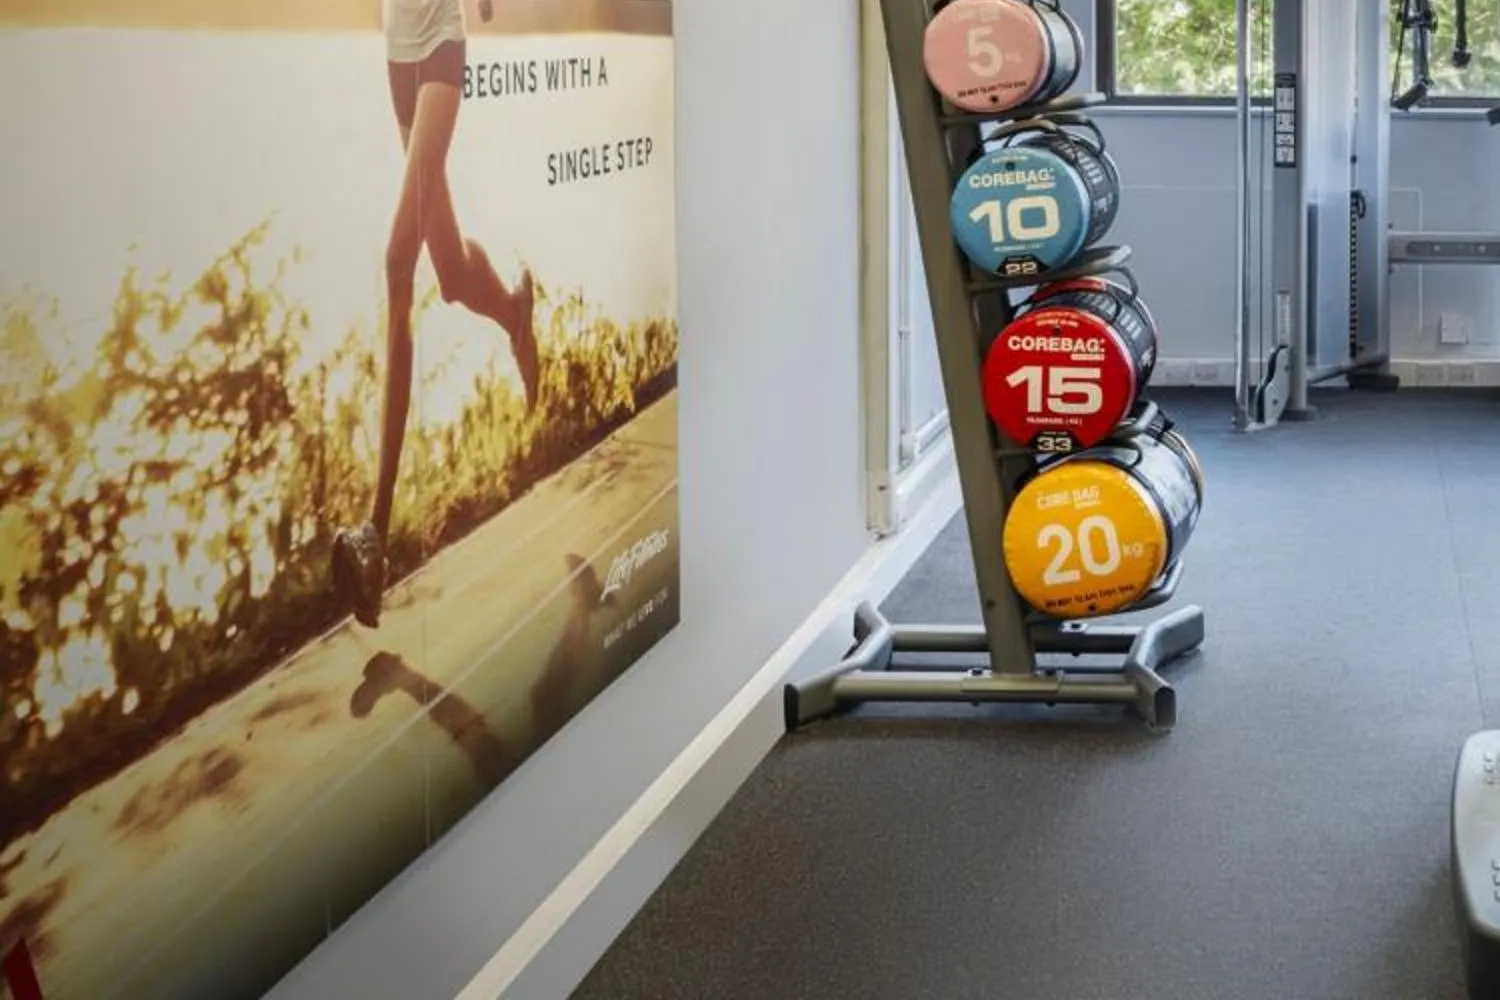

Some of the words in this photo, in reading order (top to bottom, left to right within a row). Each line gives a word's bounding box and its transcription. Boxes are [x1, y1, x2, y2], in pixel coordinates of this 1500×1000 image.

[967, 25, 1003, 78] 5
[463, 60, 537, 99] BEGINS
[545, 57, 592, 91] WITH
[597, 56, 609, 86] A
[547, 144, 610, 186] SINGLE
[617, 137, 653, 171] STEP
[968, 195, 1060, 243] 10
[1005, 365, 1103, 415] 15
[1036, 437, 1072, 452] 33
[1037, 515, 1121, 585] 20
